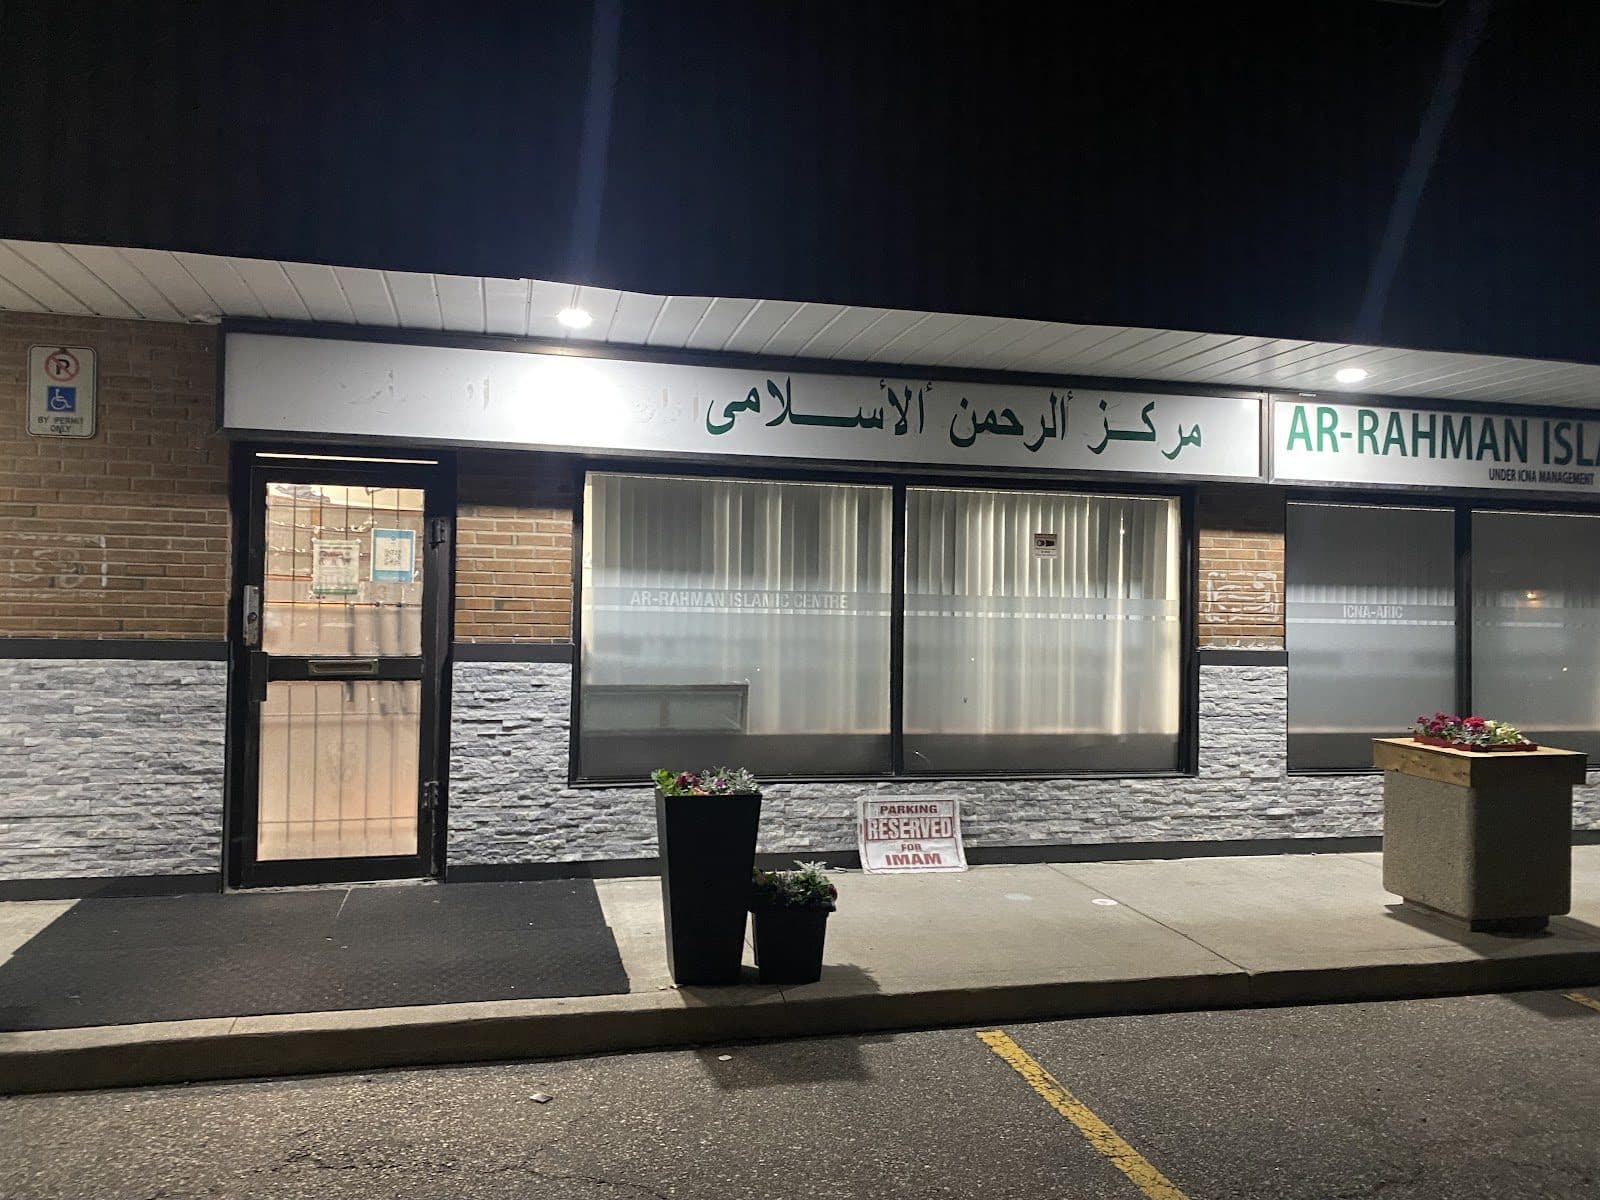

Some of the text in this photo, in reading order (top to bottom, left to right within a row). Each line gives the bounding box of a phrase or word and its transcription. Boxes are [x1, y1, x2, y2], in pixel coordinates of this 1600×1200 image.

[38, 416, 84, 425] BY PERMIT
[50, 425, 72, 433] ONLY
[1087, 399, 1202, 460] مركز
[1286, 405, 1600, 466] AR-RAHMAN ISL
[1489, 468, 1516, 481] UNDER
[1539, 471, 1594, 485] MANAGEMENT
[630, 590, 849, 609] AR-RAHMAN ISLAMIC CENTRE
[880, 805, 938, 814] PARKING
[868, 817, 953, 840] RESERVED
[901, 843, 922, 852] FOR
[885, 853, 942, 866] IMAM
